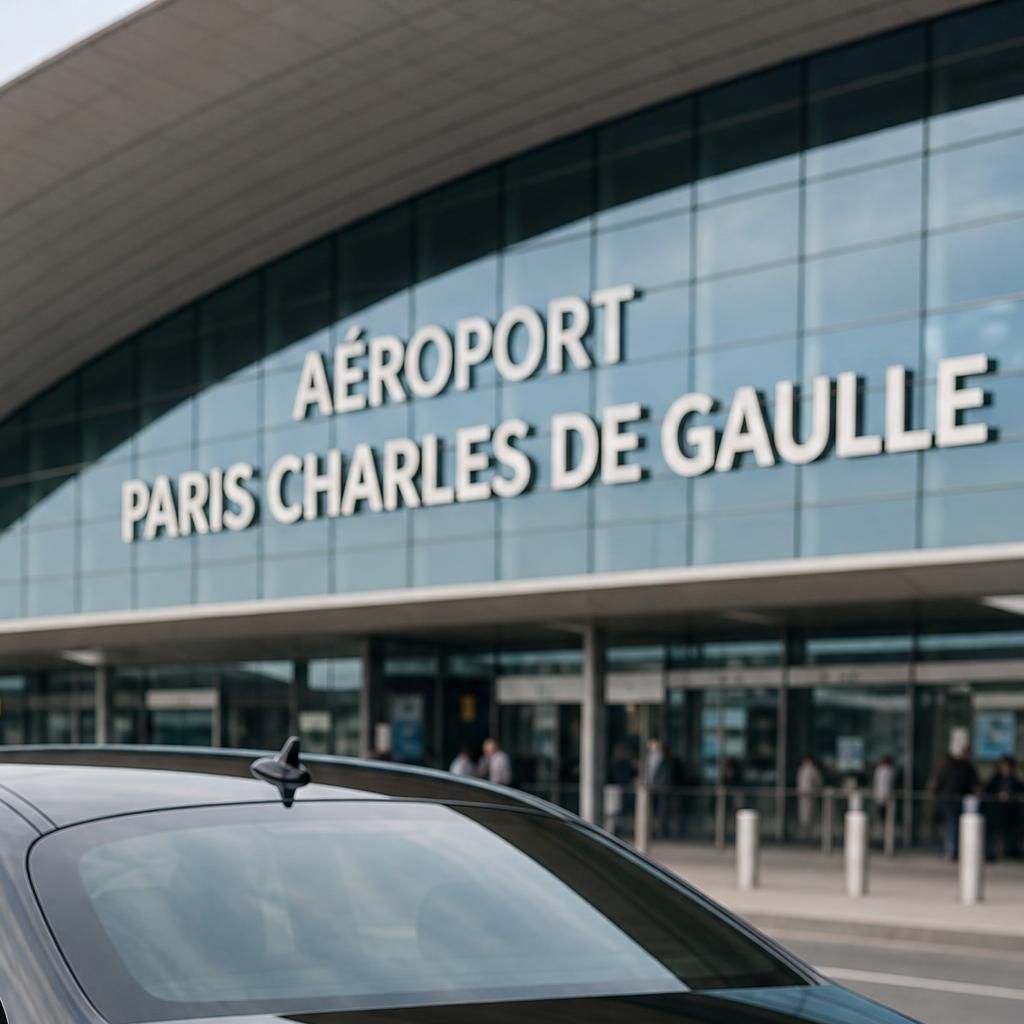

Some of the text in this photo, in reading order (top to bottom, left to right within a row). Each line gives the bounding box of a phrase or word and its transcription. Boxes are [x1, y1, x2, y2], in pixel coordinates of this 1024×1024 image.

[292, 283, 637, 421] AÉROPORT
[120, 352, 991, 543] PARIS CHARLES DE GAULLE
